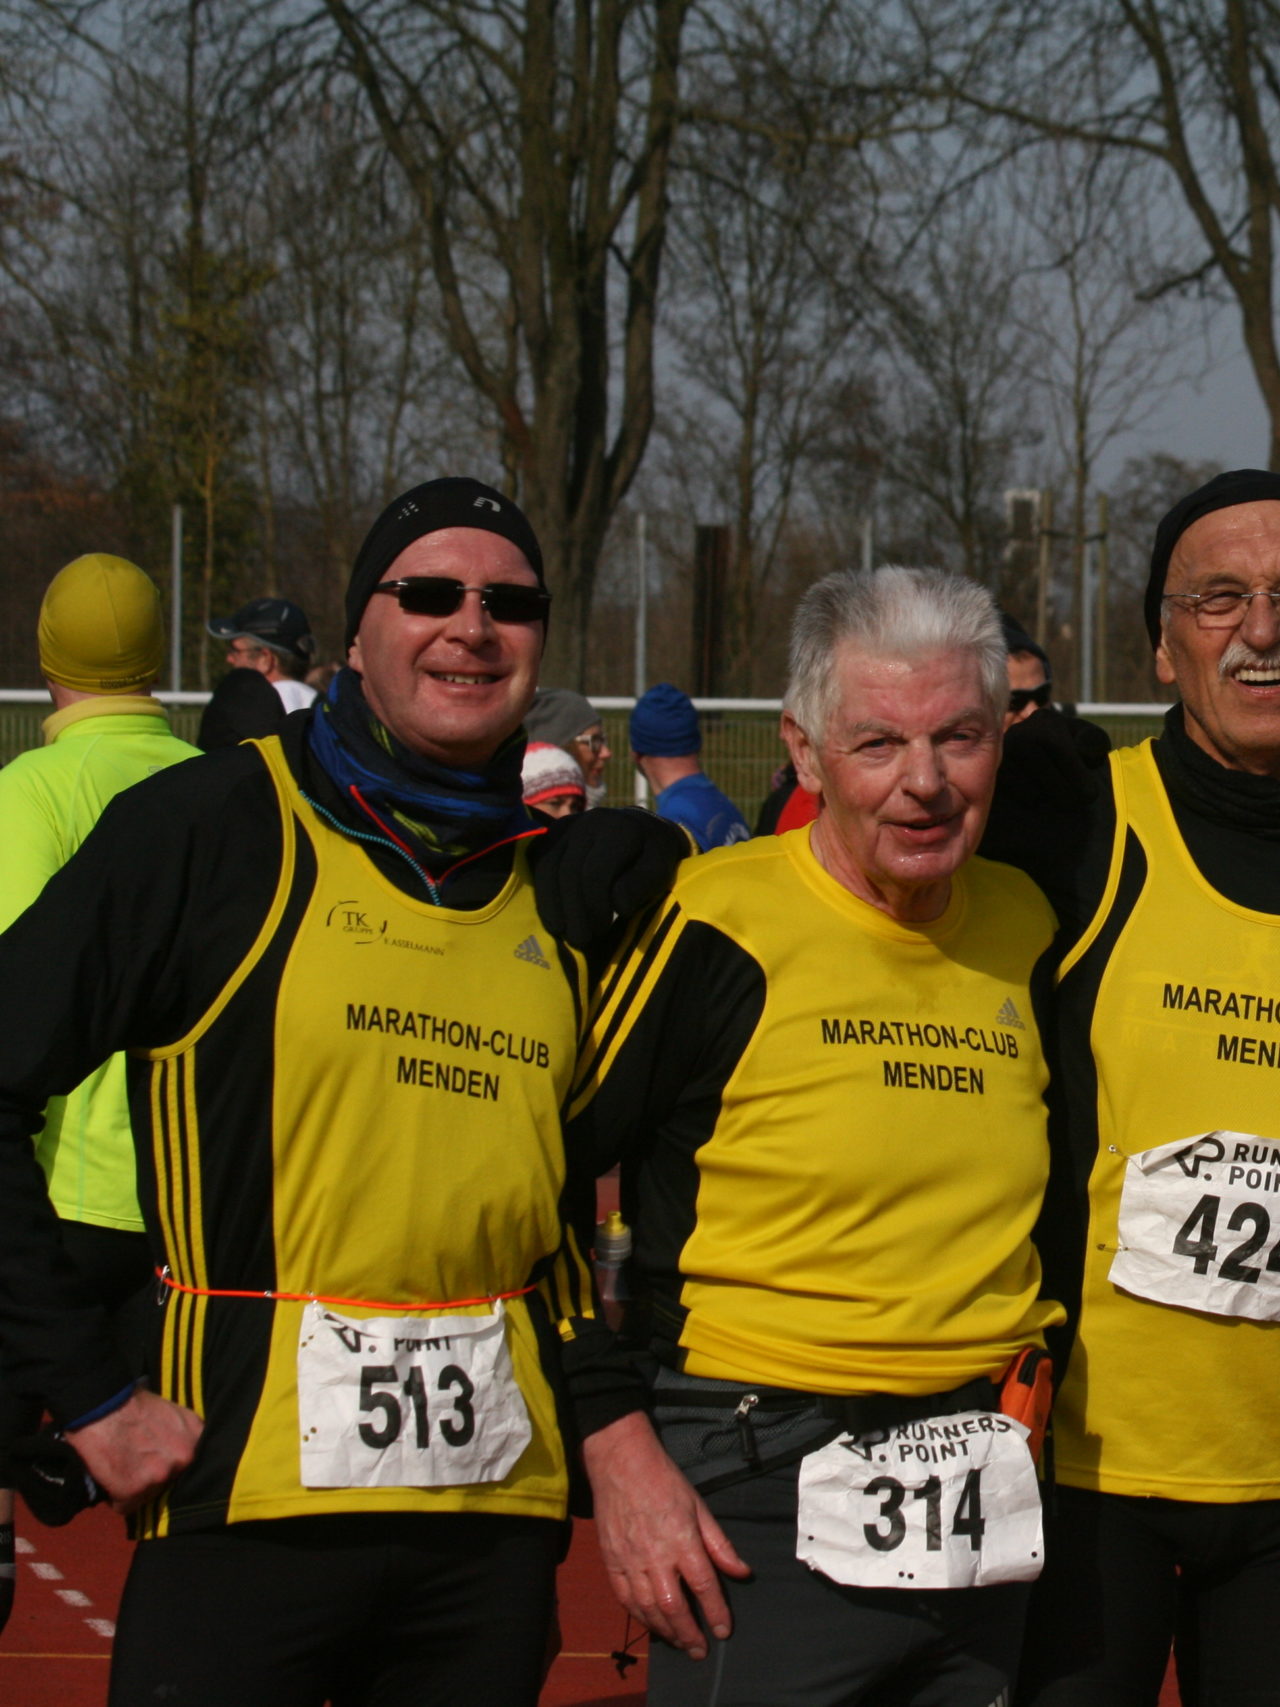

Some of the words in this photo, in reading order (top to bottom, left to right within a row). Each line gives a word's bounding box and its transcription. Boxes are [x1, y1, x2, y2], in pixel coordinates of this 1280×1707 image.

[342, 910, 370, 928] TK
[346, 1003, 550, 1069] MARATHON-CLUB
[820, 1018, 1019, 1059] MARATHON-CLUB
[396, 1055, 500, 1101] MENDEN
[883, 1060, 985, 1095] MENDEN
[358, 1364, 475, 1450] 513
[898, 1438, 970, 1464] POINT
[863, 1468, 986, 1552] 314
